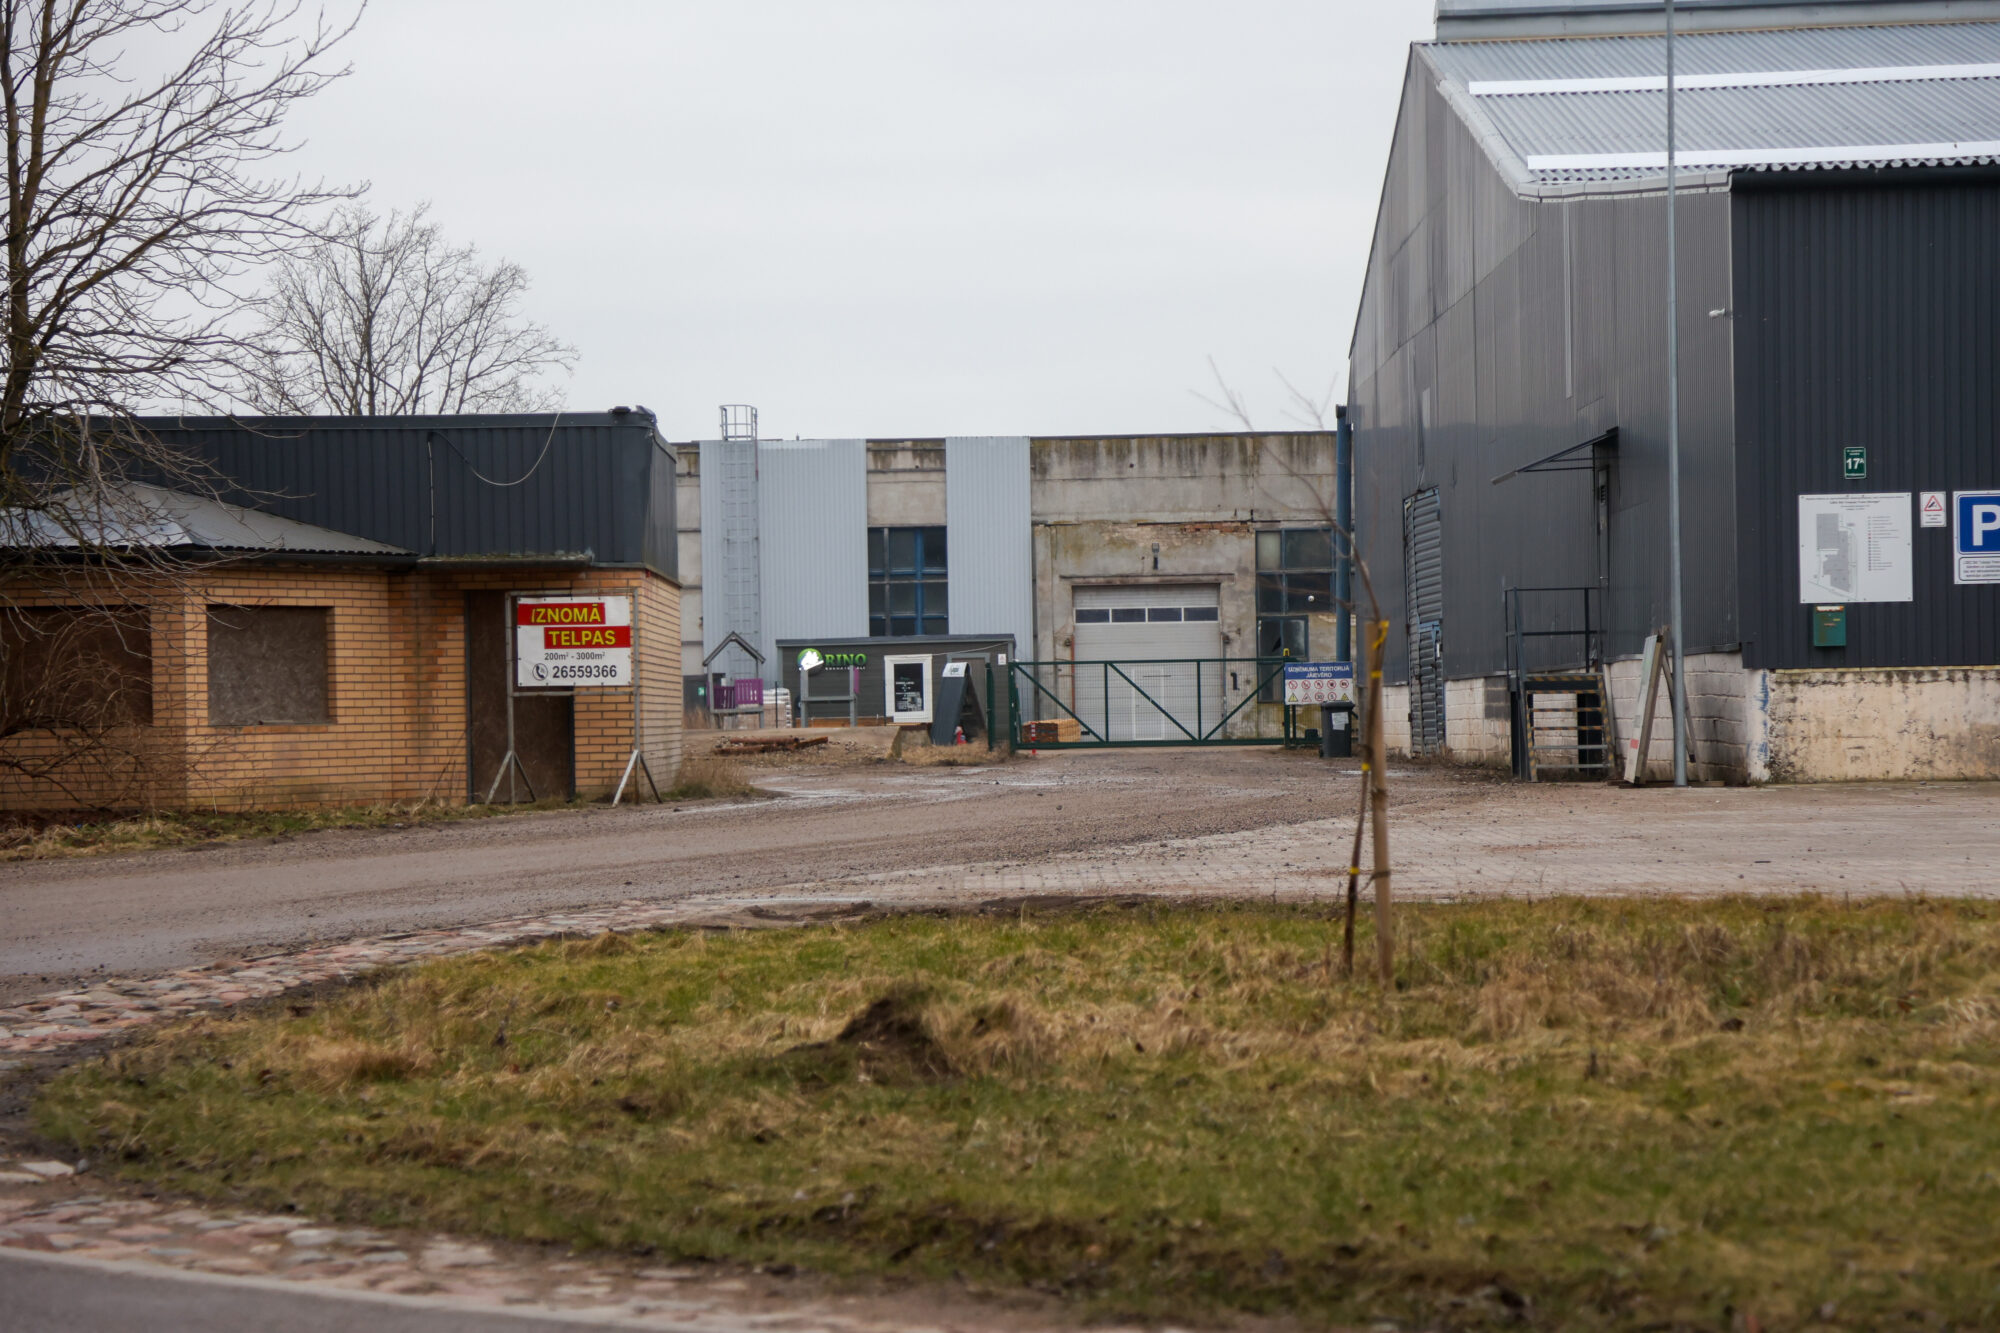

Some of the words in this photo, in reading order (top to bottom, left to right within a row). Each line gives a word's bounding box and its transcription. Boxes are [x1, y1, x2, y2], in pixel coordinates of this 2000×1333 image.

[1972, 504, 2000, 547] P
[531, 603, 601, 623] IZNOMĀ
[548, 630, 616, 646] TELPAS
[824, 653, 867, 666] RINO
[552, 665, 617, 679] 26559366
